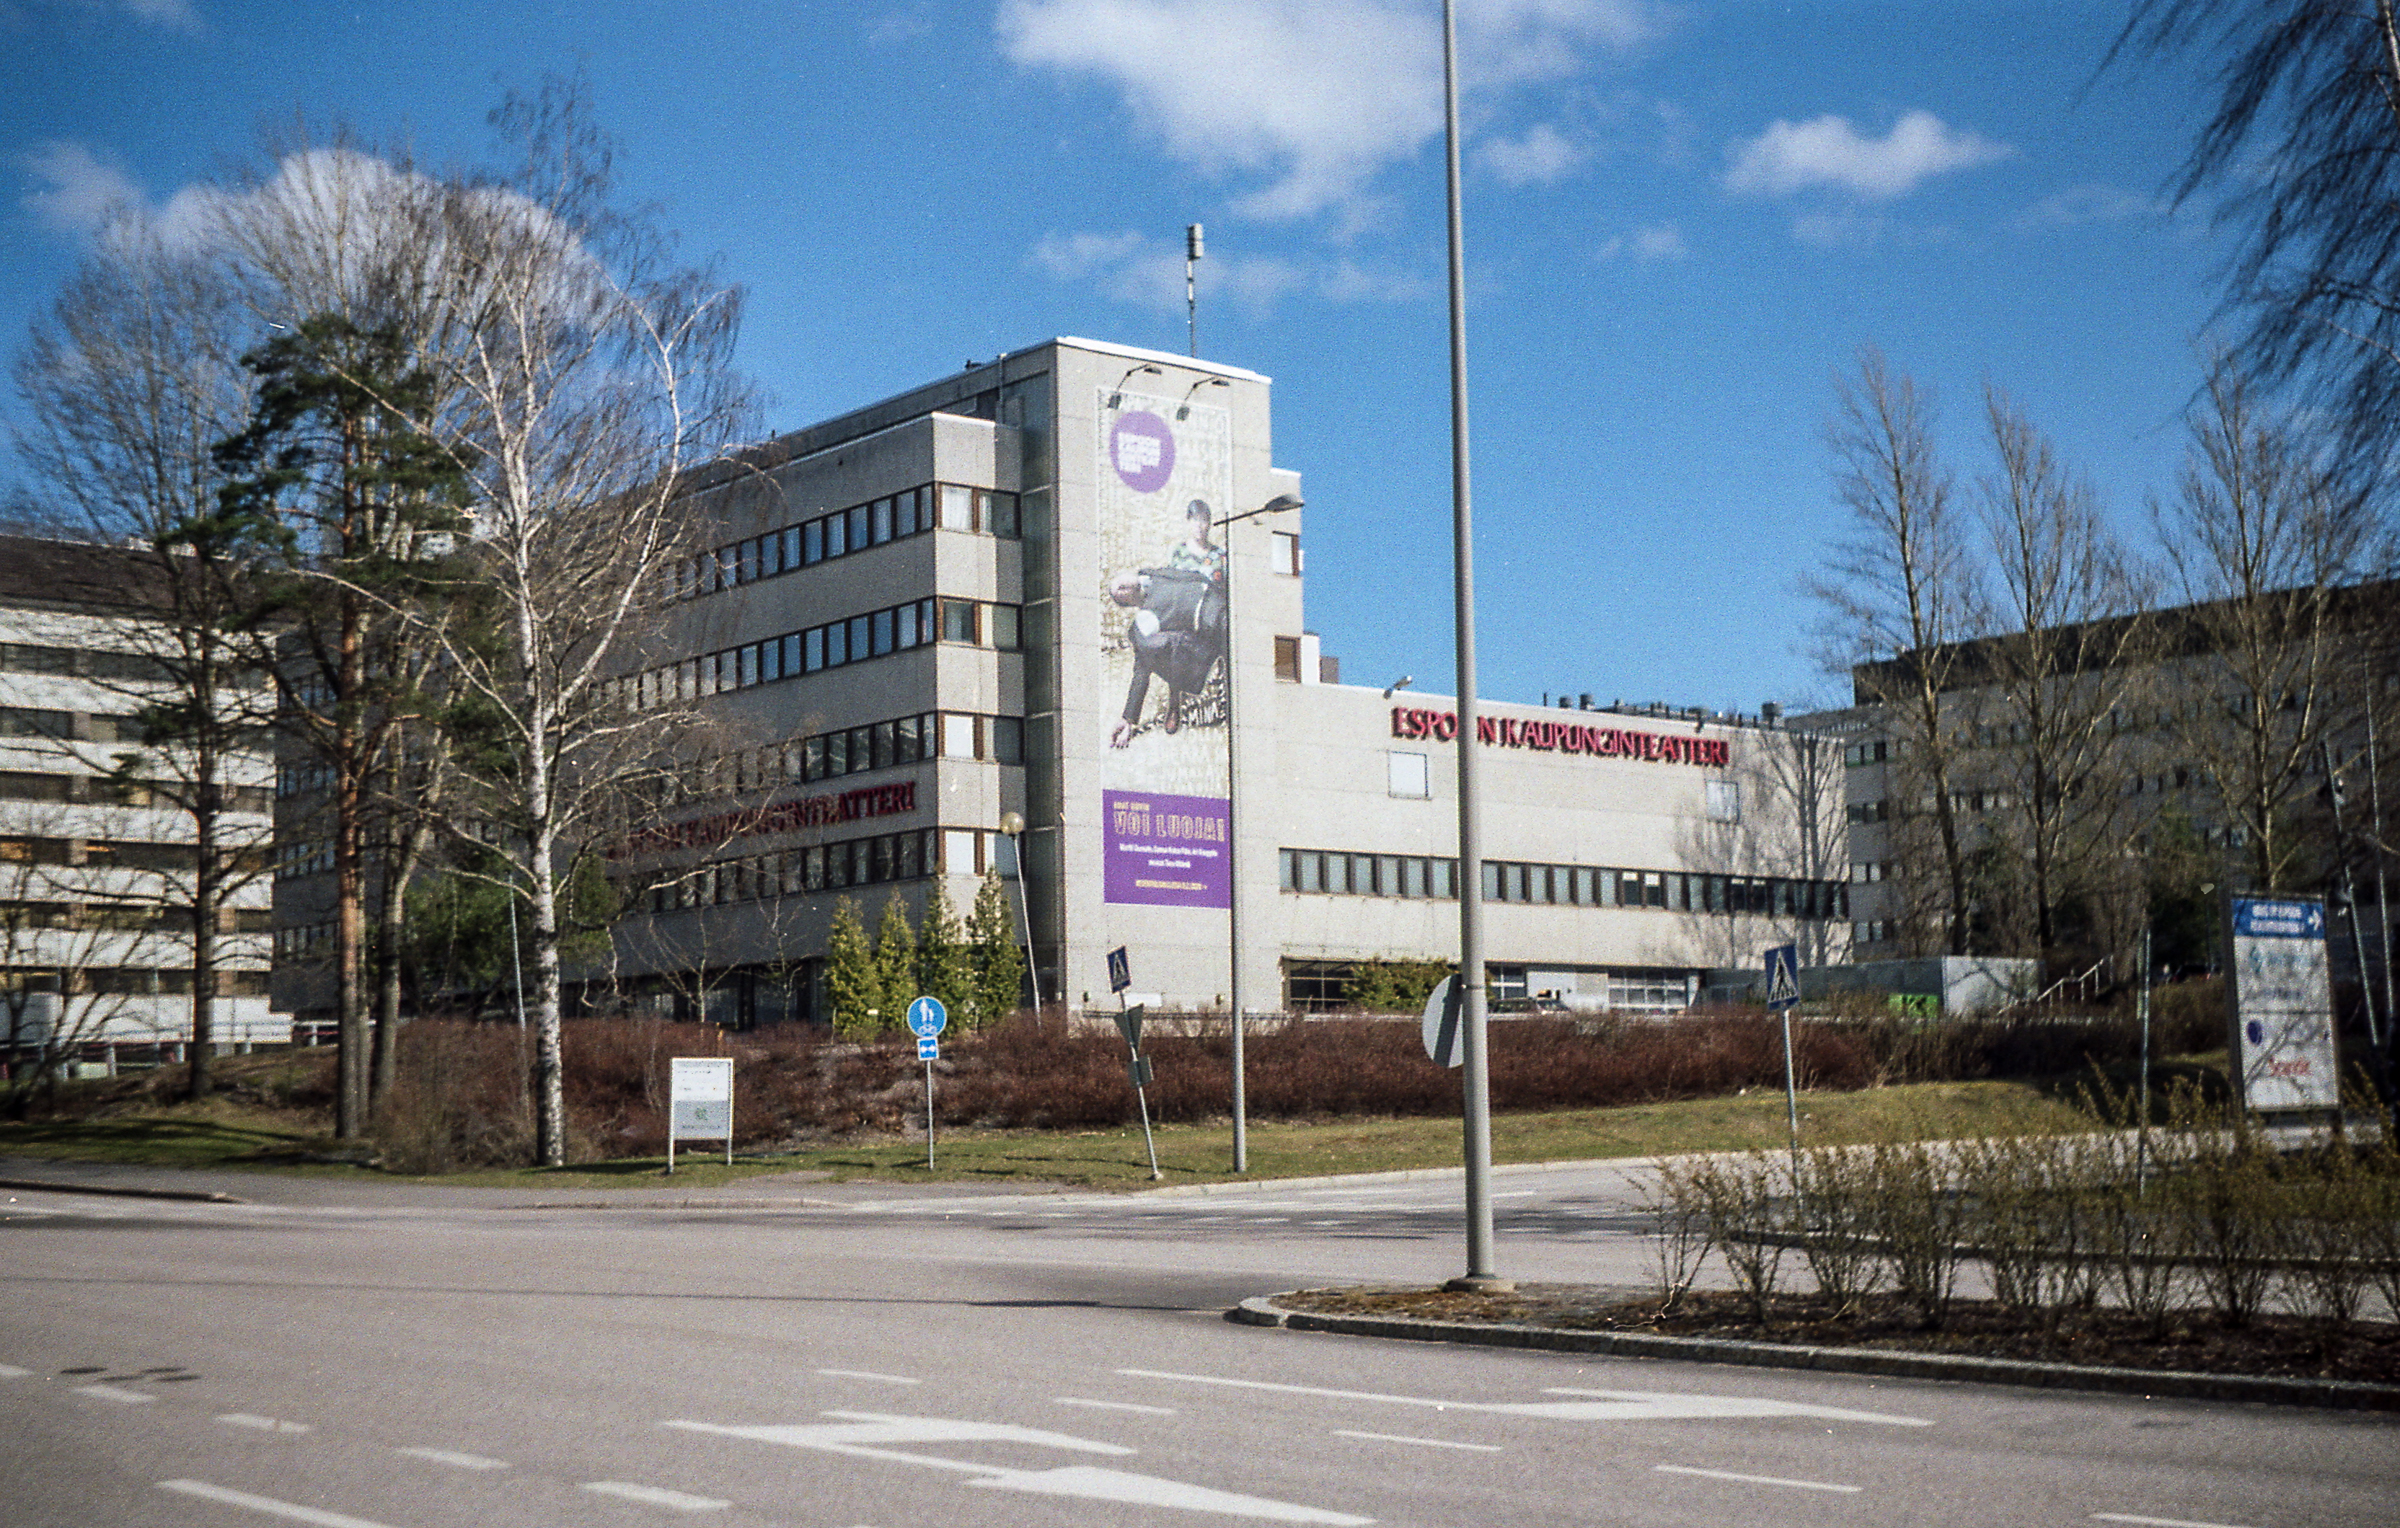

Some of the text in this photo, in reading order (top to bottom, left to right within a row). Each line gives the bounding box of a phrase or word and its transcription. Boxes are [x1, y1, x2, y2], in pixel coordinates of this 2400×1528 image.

[1392, 707, 1729, 765] ESPON KAUPUNGINTEATTERI
[1113, 810, 1150, 836] VOI
